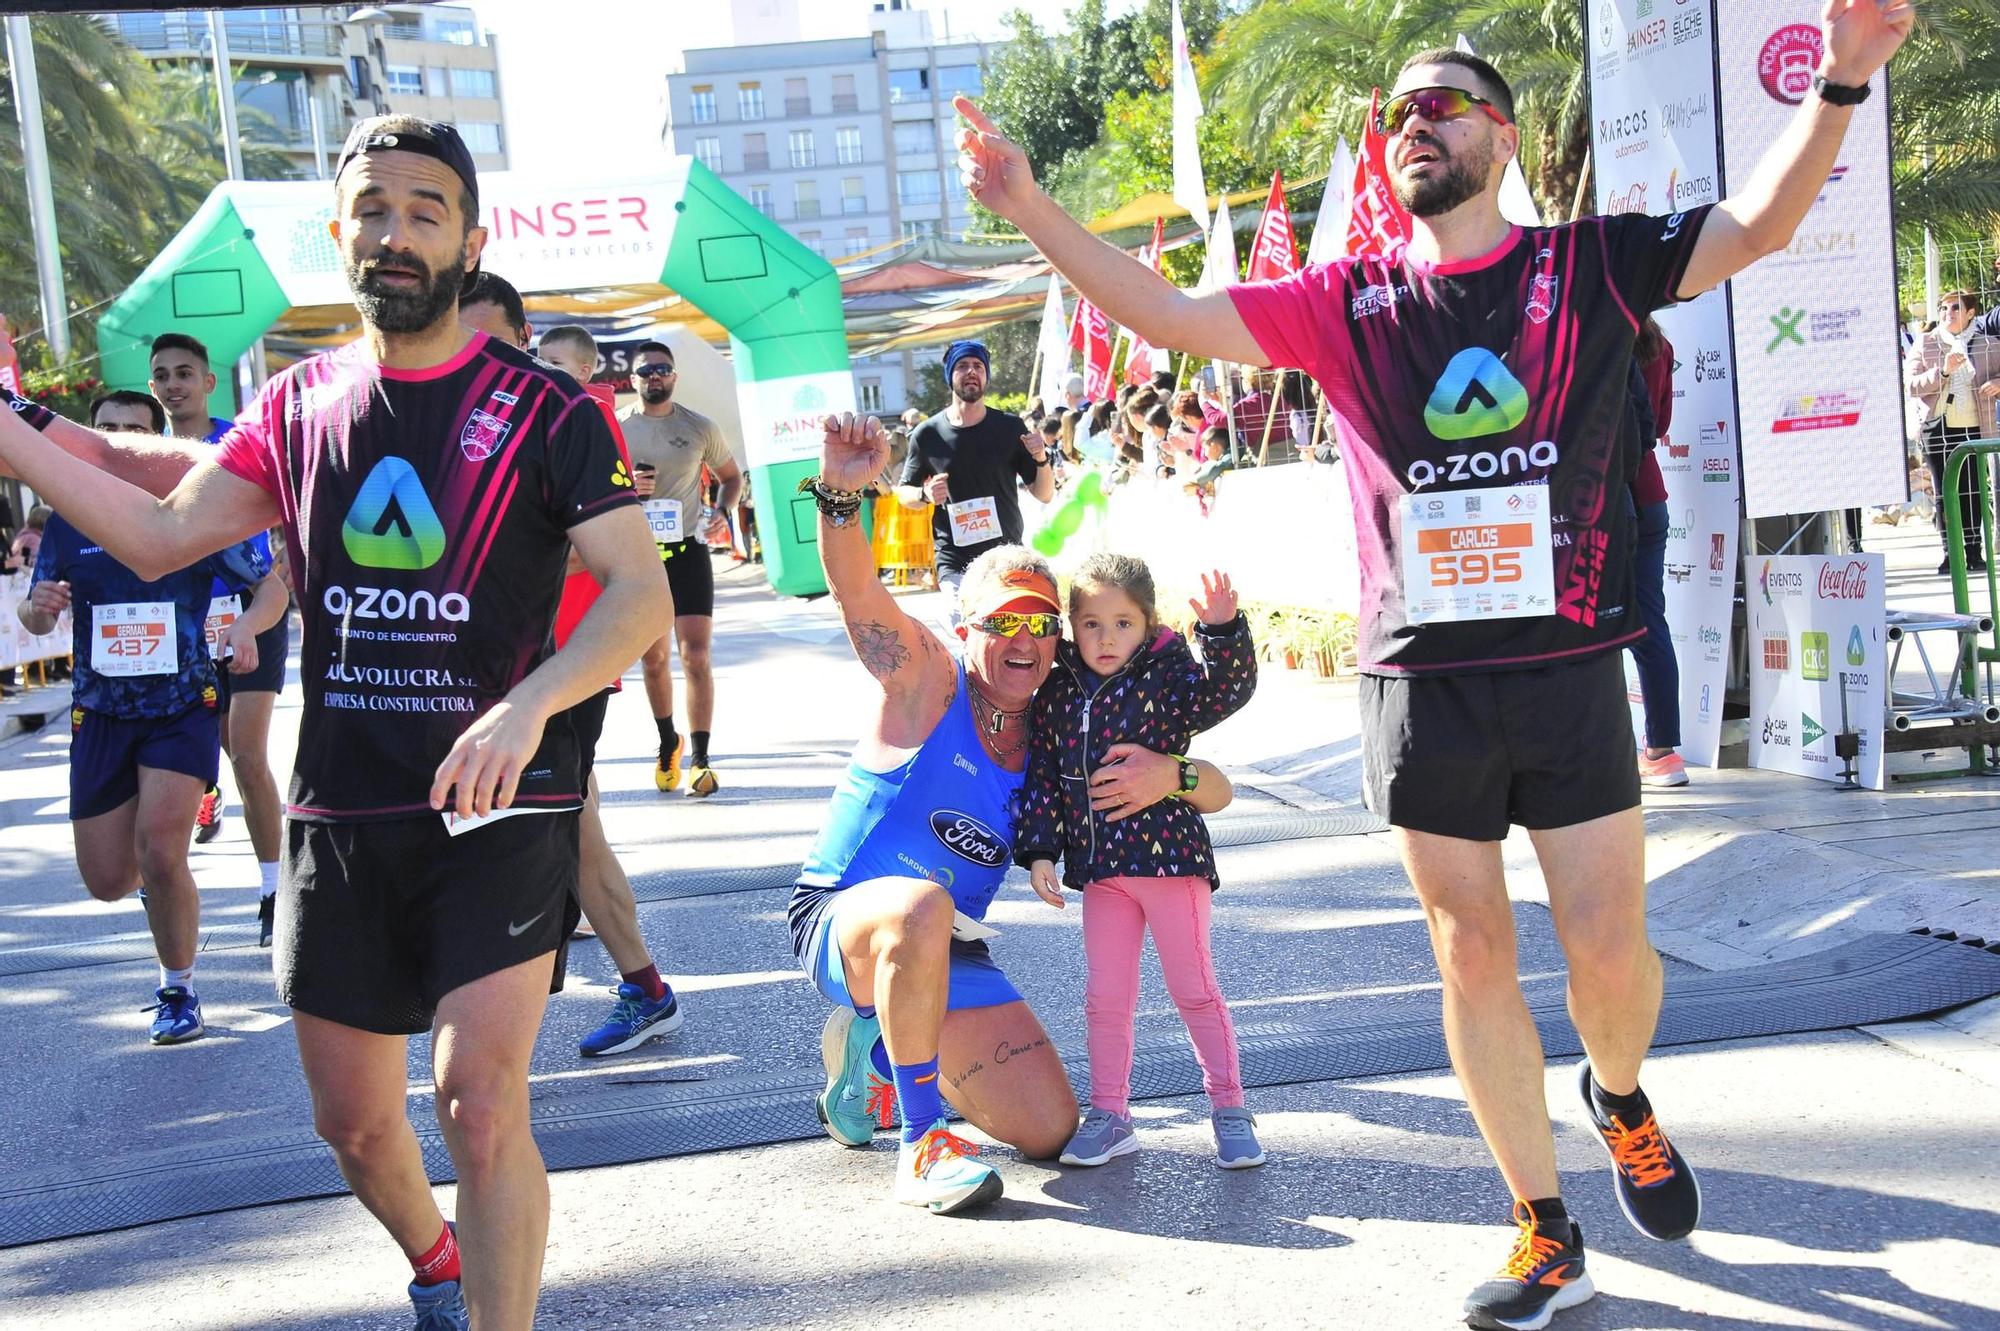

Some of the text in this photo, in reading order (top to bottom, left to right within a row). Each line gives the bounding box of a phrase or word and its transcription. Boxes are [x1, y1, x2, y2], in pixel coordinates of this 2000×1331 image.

[1673, 12, 1702, 36] ELCHE
[1673, 27, 1703, 46] DECATLON
[1600, 109, 1648, 145] MARCOS
[1676, 175, 1712, 199] EVENTOS
[1706, 350, 1721, 363] CASH
[1707, 367, 1726, 380] GOLME
[1702, 458, 1729, 471] ASELO
[959, 518, 990, 535] 744
[1450, 528, 1499, 550] CARLOS
[1430, 552, 1522, 588] 595
[1769, 572, 1802, 587] EVENTOS
[117, 624, 148, 637] GERMAN
[391, 632, 457, 643] ENCUENTRO
[1704, 626, 1722, 644] elche
[107, 638, 160, 657] 437
[1803, 648, 1827, 670] CRC
[325, 691, 475, 713] EMPRESA CONSTRUCTORA
[1775, 719, 1787, 731] CASH
[1774, 735, 1791, 746] GOLME
[945, 818, 997, 862] Ford
[897, 852, 930, 877] GARDEN
